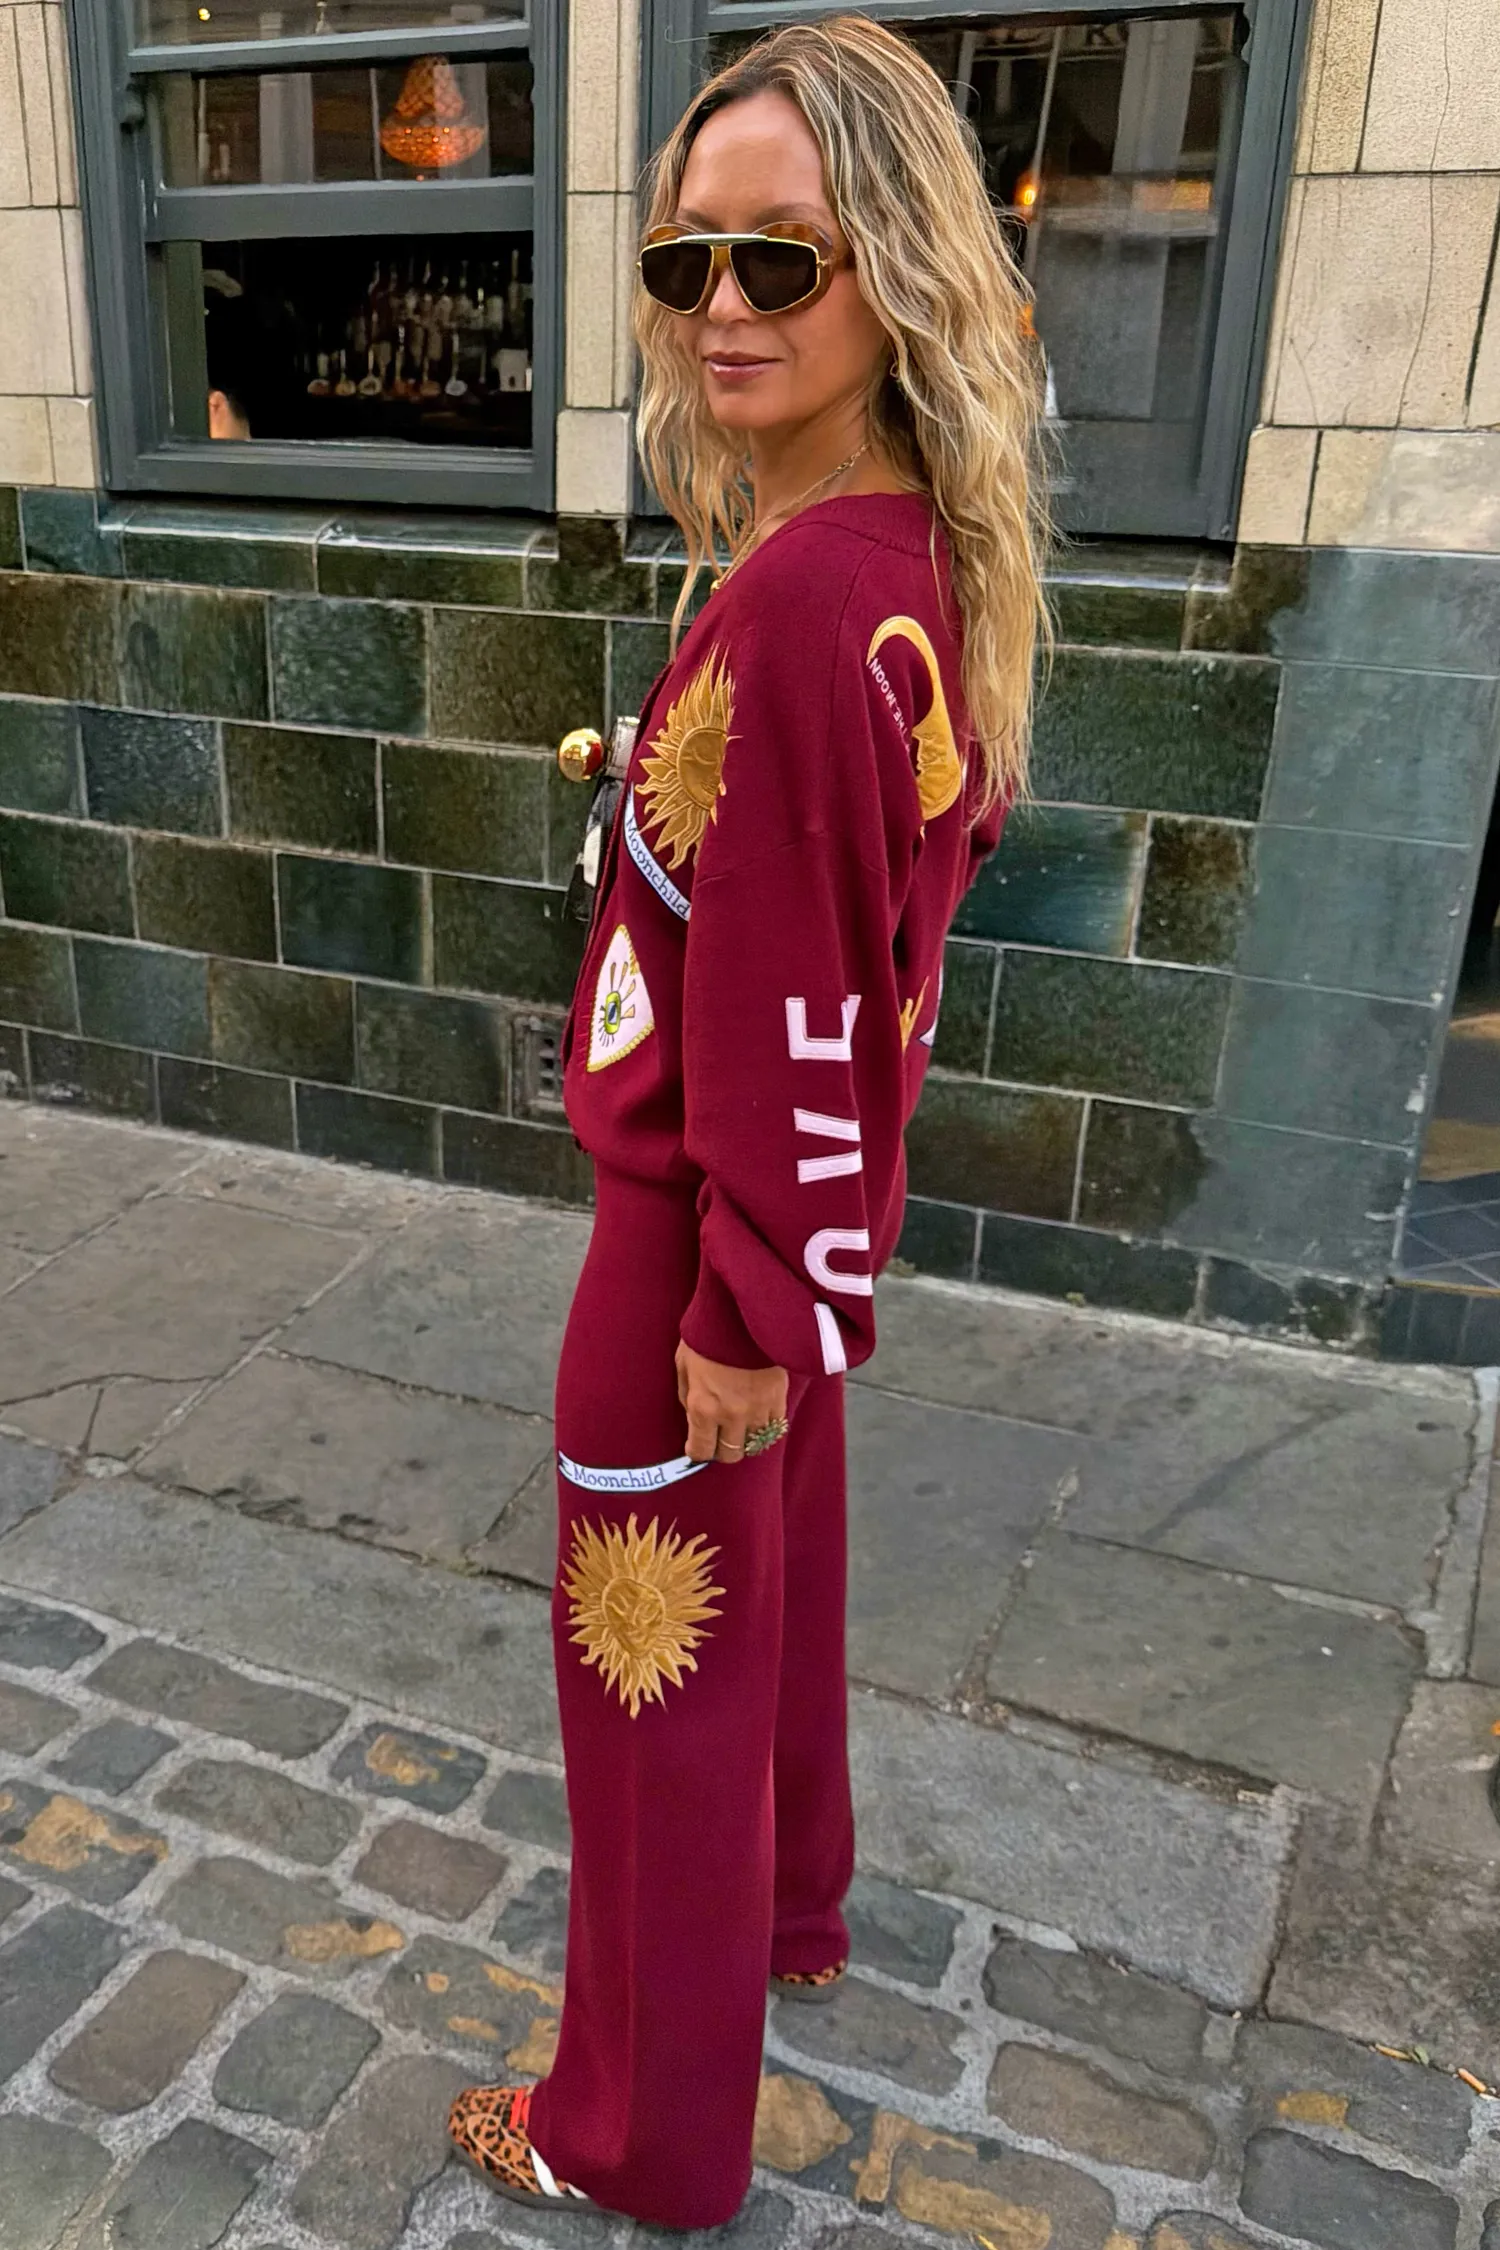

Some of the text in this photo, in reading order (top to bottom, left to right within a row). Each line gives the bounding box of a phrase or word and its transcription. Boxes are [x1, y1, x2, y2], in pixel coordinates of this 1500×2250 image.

[868, 657, 897, 707] MOON
[626, 816, 691, 918] Moonchild
[573, 1464, 668, 1488] Moonchild
